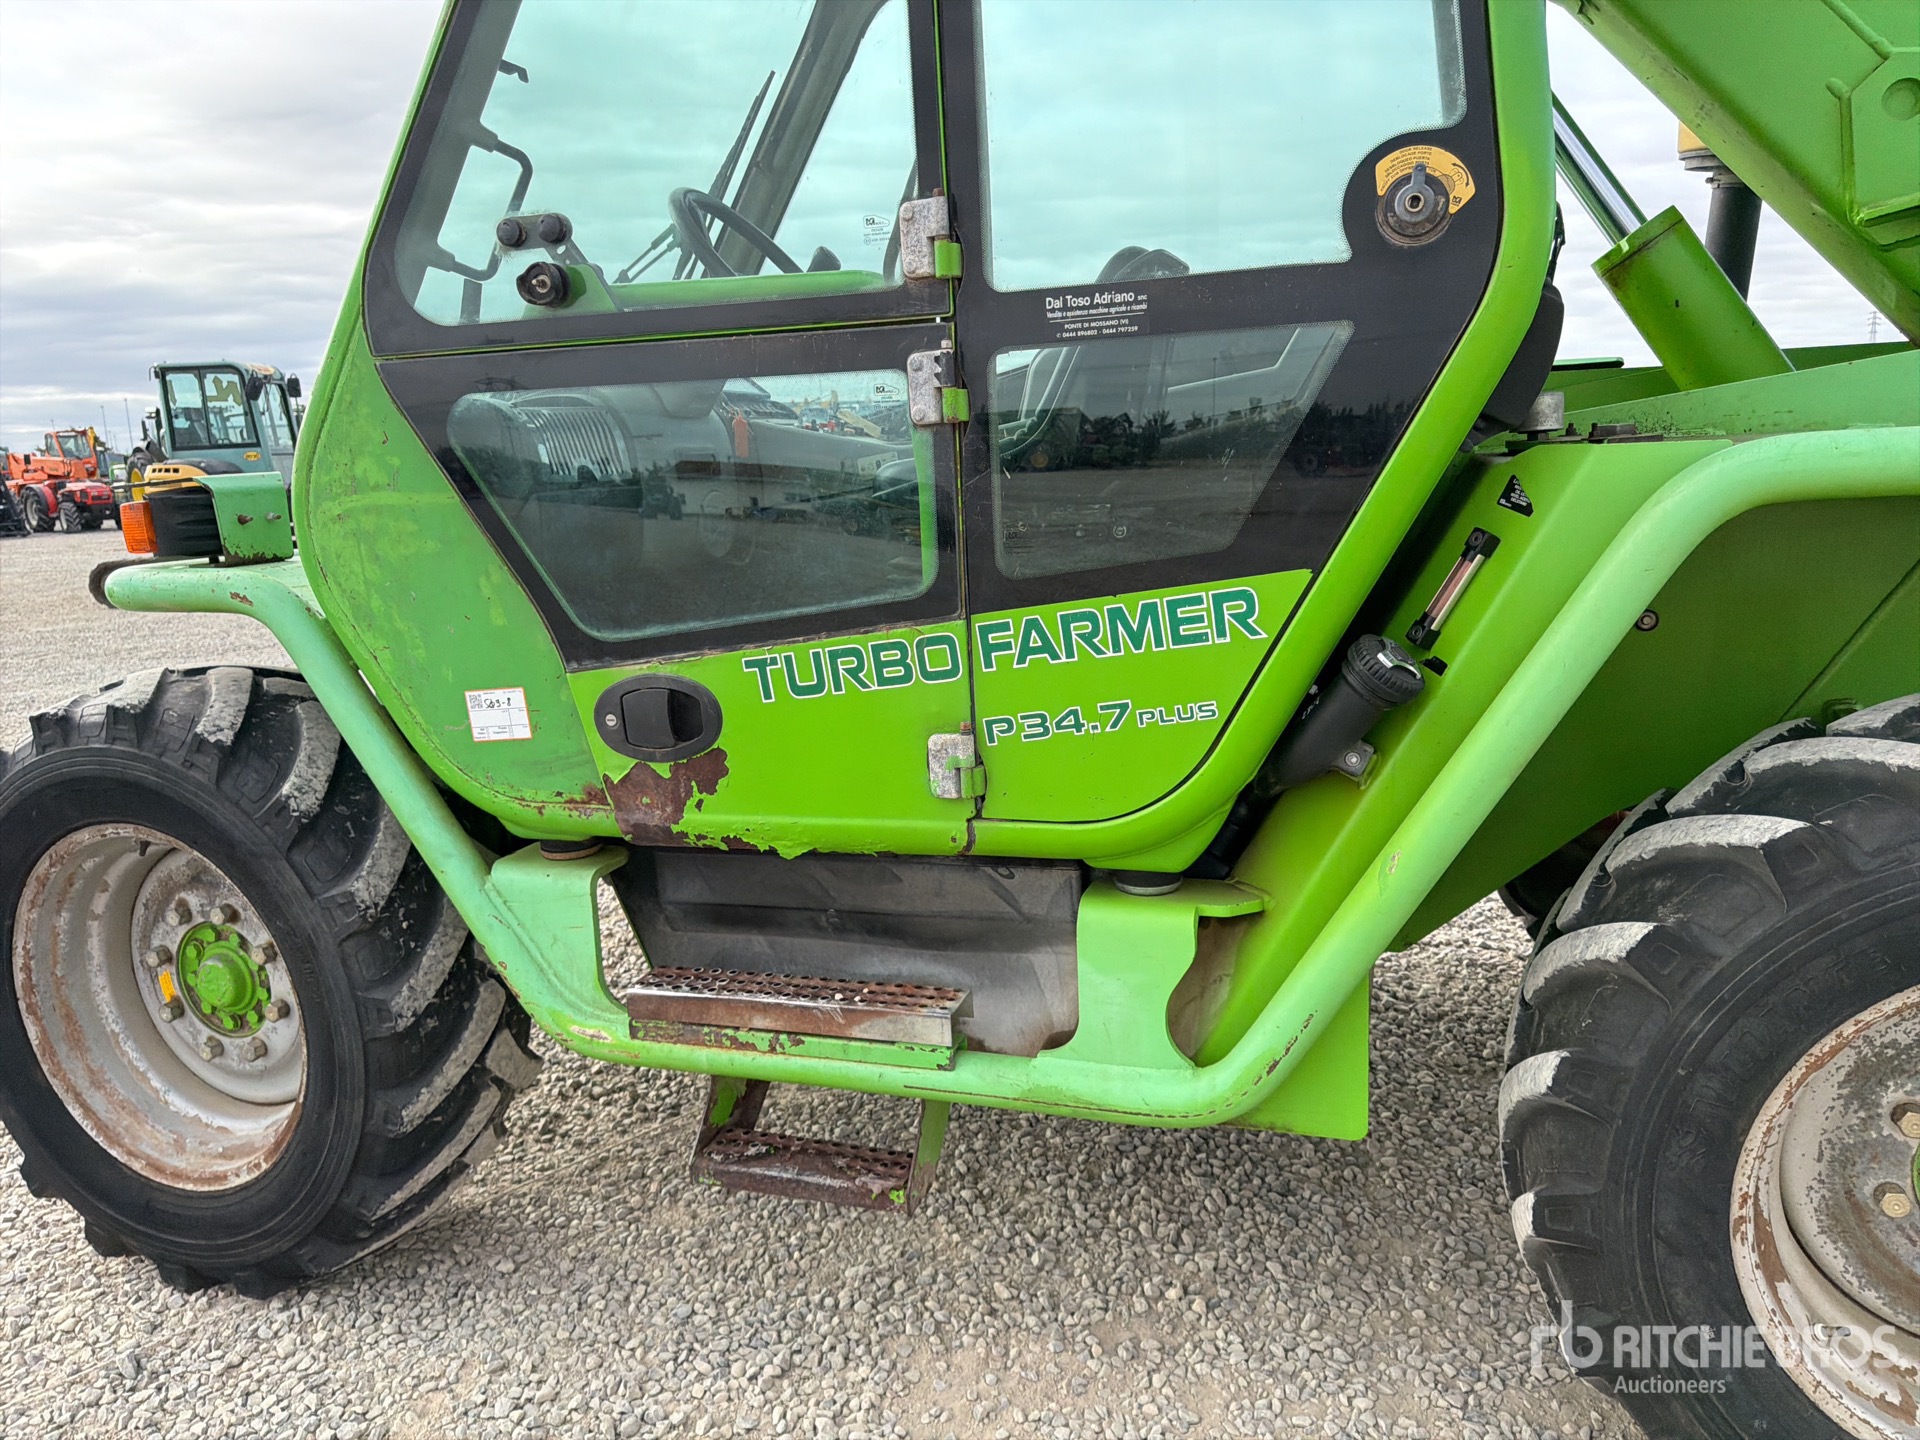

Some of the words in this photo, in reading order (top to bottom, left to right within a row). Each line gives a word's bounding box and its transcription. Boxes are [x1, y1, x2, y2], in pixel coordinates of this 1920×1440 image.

[1045, 296, 1063, 309] Dal
[1065, 294, 1091, 308] Toso
[1093, 291, 1135, 305] Adriano
[1064, 322, 1082, 330] PONTE
[1089, 318, 1119, 328] MOSSANO
[1102, 327, 1117, 335] 0444
[742, 632, 963, 703] TURBO
[976, 586, 1268, 672] FARMER
[983, 700, 1132, 747] P34.7
[1137, 701, 1218, 728] PLUS
